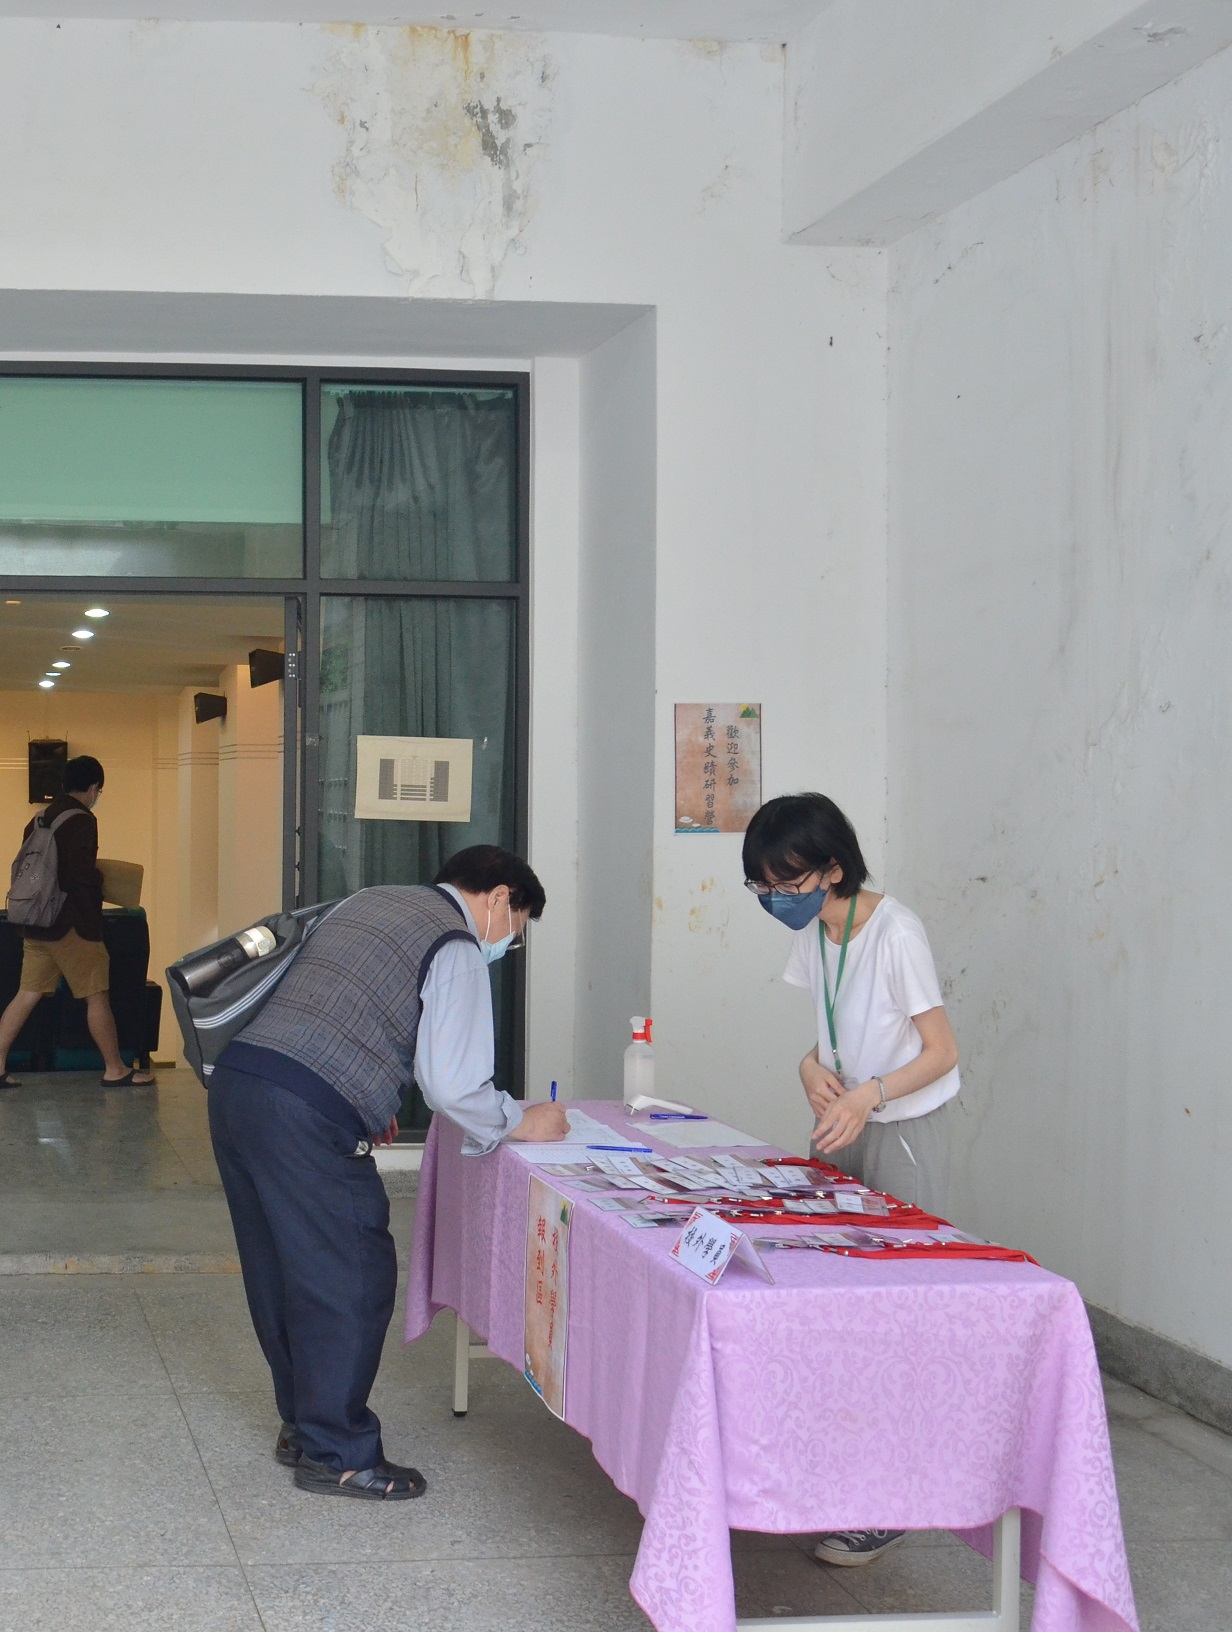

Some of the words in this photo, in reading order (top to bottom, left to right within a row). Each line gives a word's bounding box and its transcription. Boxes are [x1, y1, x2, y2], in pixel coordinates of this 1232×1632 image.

[703, 708, 716, 826] 嘉義史蹟研習營
[725, 724, 740, 787] 歡迎參加
